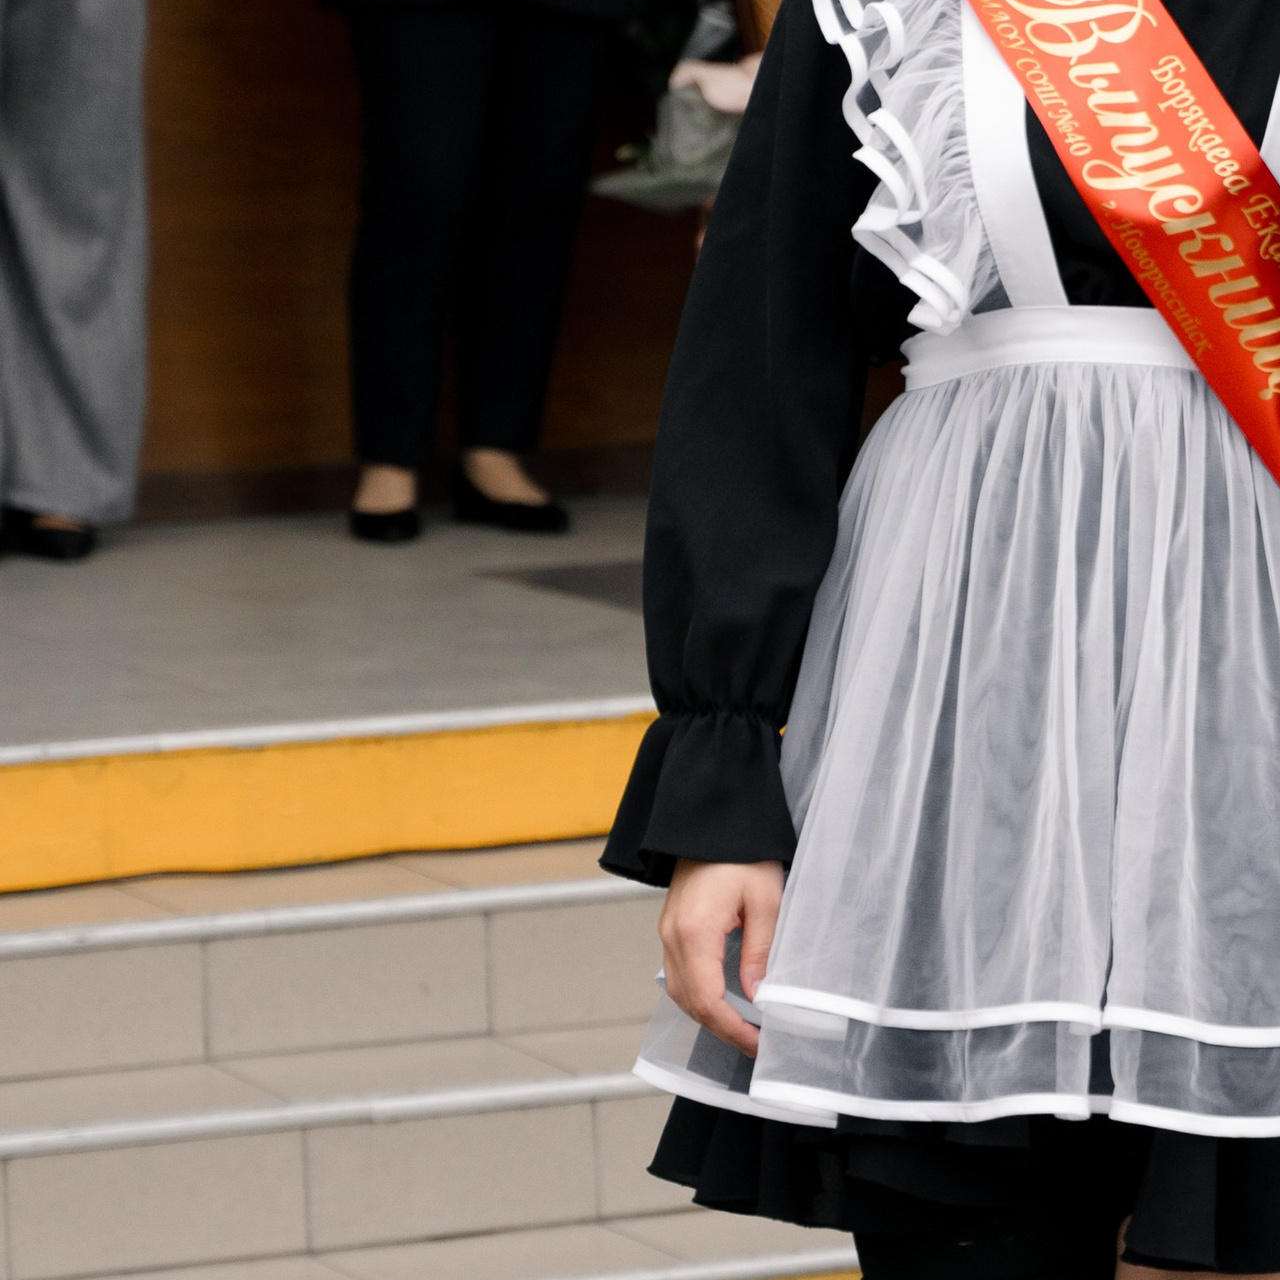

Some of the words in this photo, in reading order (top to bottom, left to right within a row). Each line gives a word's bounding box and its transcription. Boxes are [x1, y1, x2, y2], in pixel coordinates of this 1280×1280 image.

[1016, 57, 1067, 108] СОШ
[1151, 55, 1250, 196] Борякаева
[1110, 217, 1213, 361] Новороссийск
